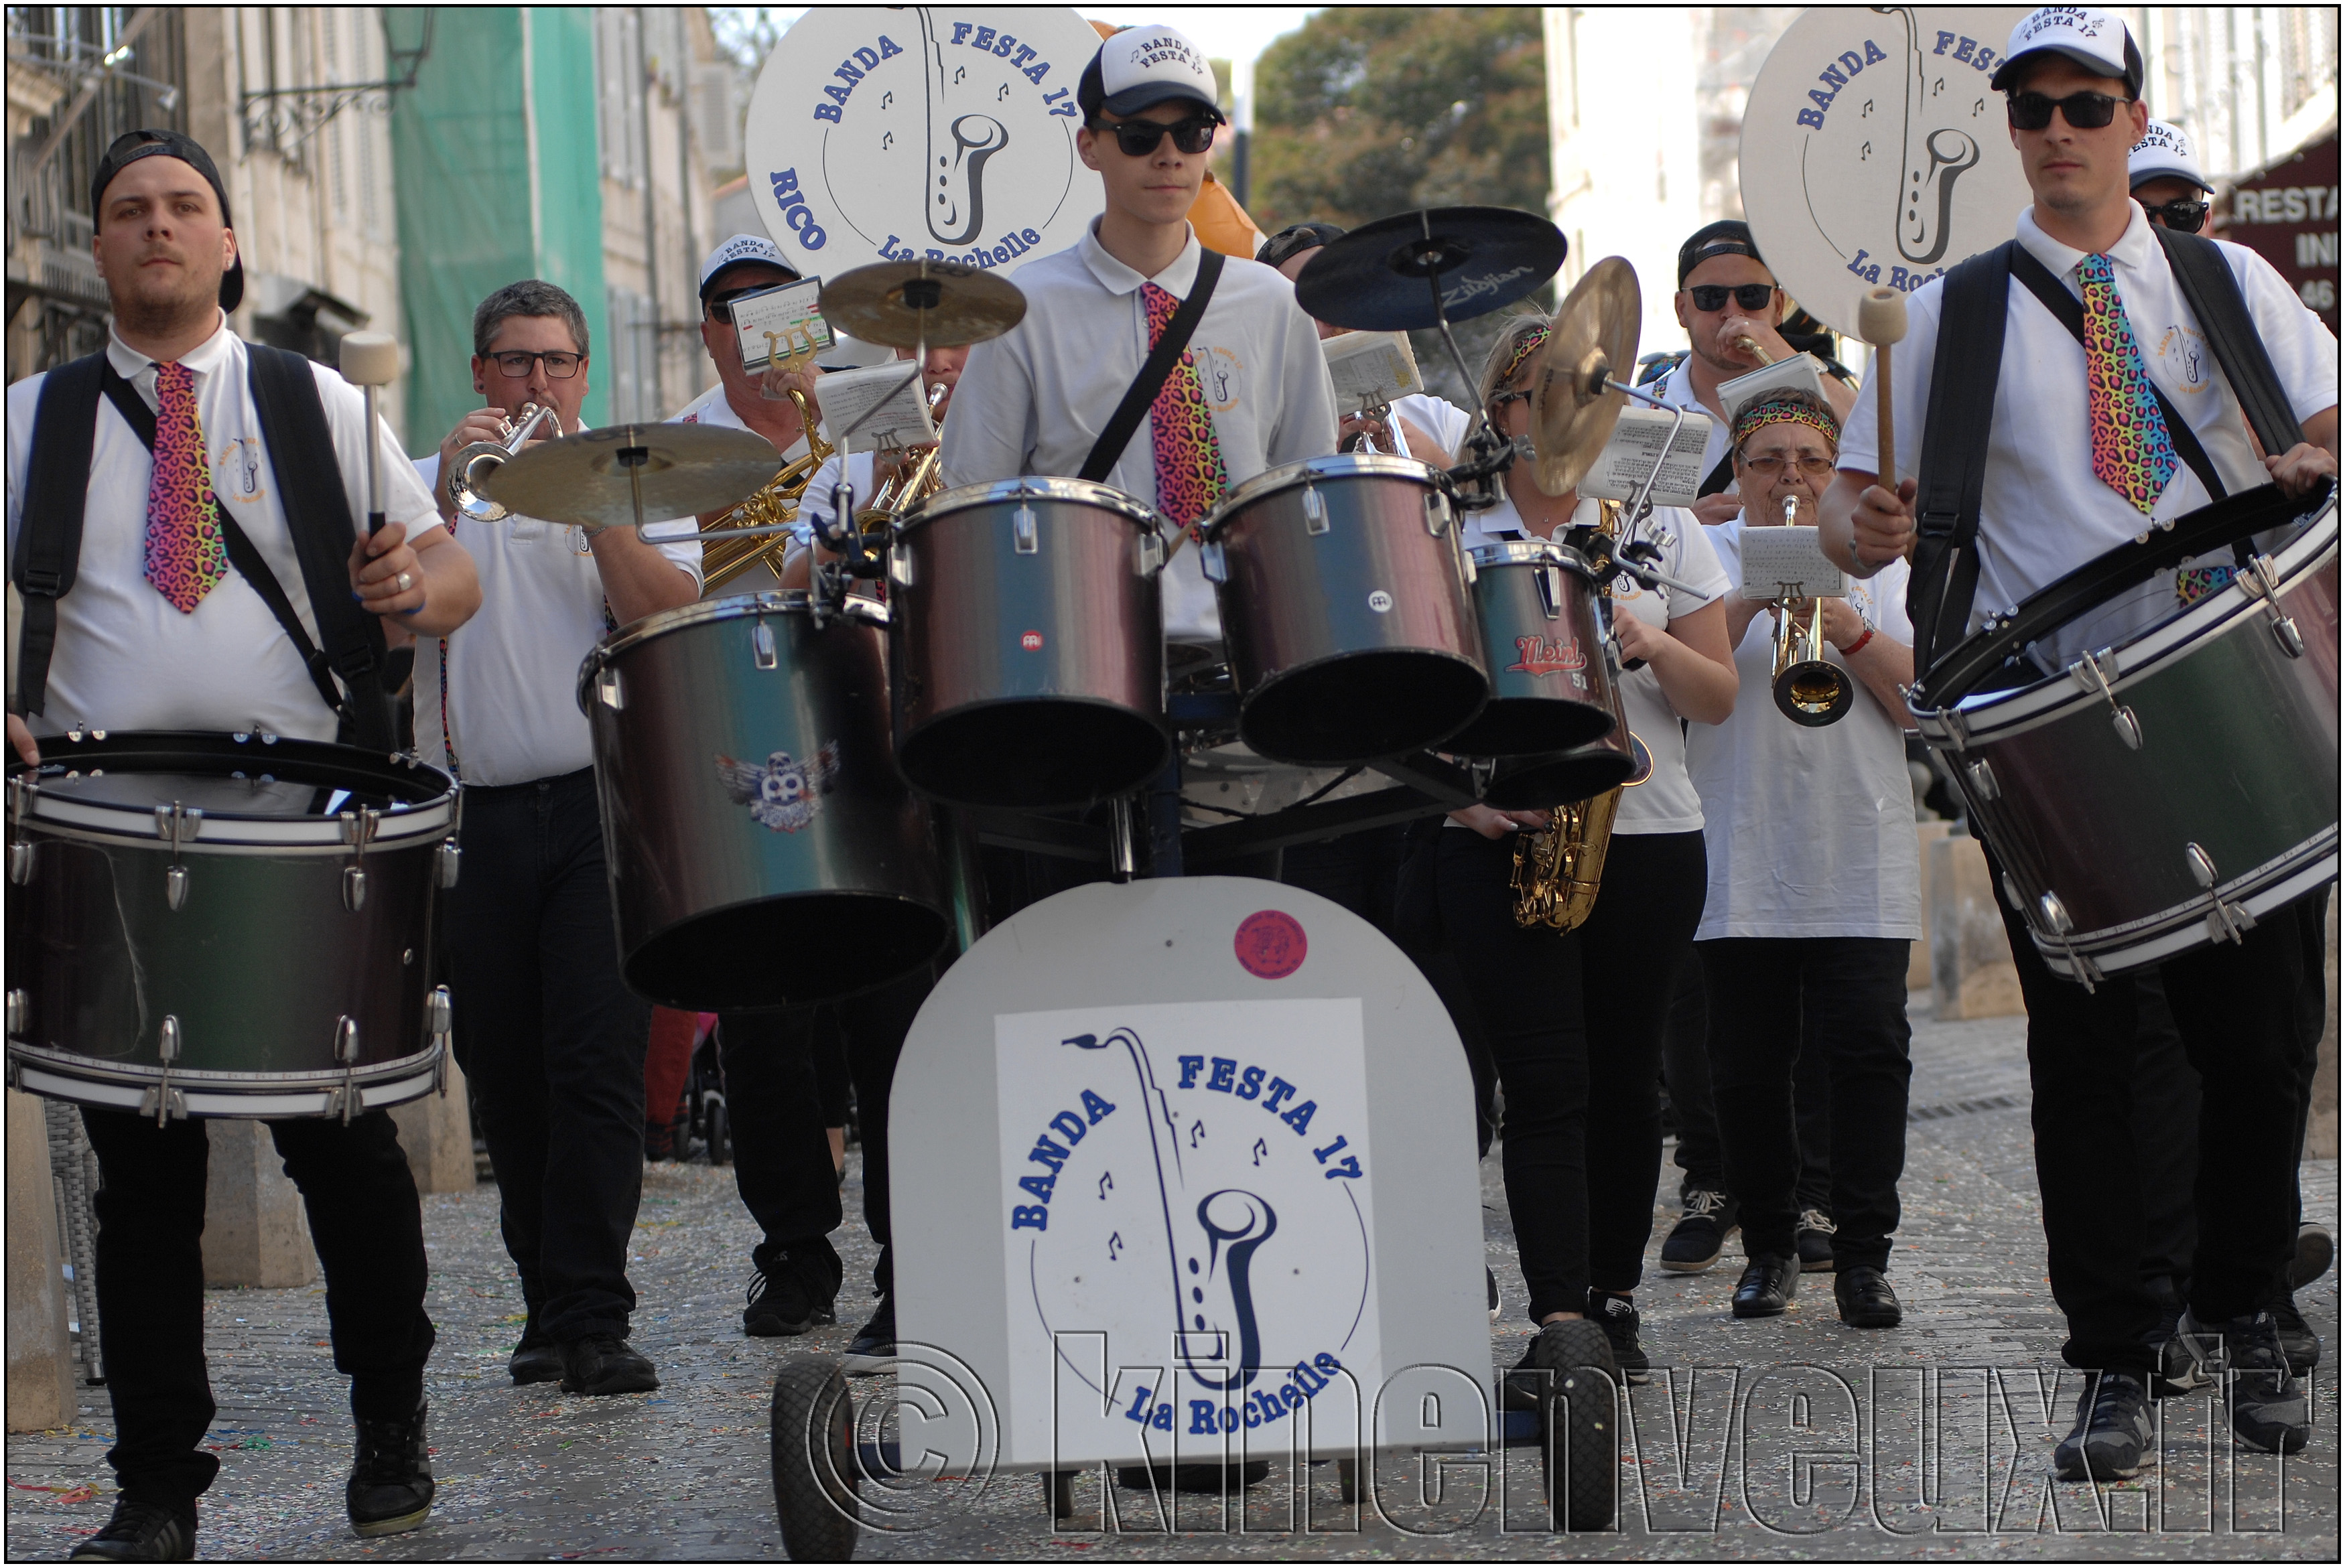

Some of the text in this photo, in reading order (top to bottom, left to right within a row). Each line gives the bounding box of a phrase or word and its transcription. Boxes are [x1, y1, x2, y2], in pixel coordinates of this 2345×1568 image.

[2024, 15, 2097, 41] FESTA 17
[2031, 7, 2087, 23] BANDA
[1140, 38, 1191, 58] BANDA
[1140, 50, 1203, 75] FESTA 17
[813, 21, 1077, 124] BANDA FESTA 17
[1797, 39, 1887, 131] BANDA
[2129, 137, 2187, 158] ESTA 17
[770, 167, 827, 252] RICO
[722, 246, 775, 263] FESTA 17
[725, 240, 764, 254] BANDA
[878, 234, 915, 263] La
[1847, 249, 1881, 284] La
[1441, 265, 1534, 309] Zildjian
[1514, 635, 1587, 668] Meinl
[1571, 672, 1588, 690] 51
[1012, 1055, 1363, 1231] BANDA FESTA 17
[1125, 1352, 1341, 1435] La Rochelle
